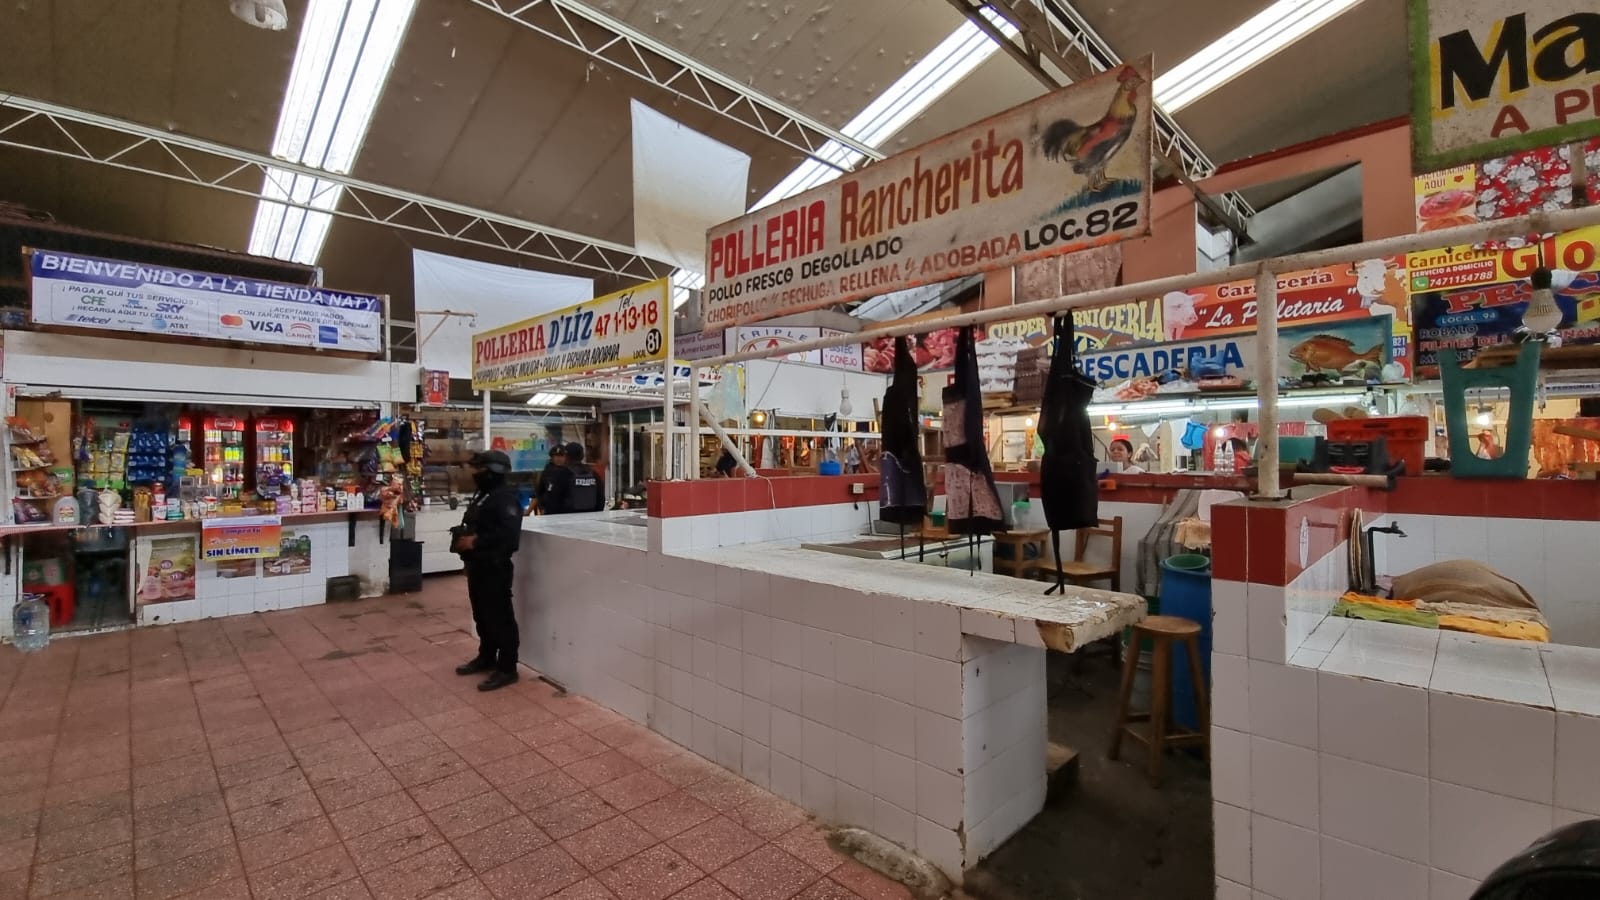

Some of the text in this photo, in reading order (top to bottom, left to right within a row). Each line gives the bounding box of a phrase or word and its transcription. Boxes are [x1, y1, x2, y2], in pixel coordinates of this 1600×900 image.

[1490, 104, 1530, 138] A
[710, 129, 1023, 284] POLLERIA Rancherita
[709, 236, 903, 304] POLLO FRESCO DEGOLLADO
[782, 279, 836, 307] PECHUGA
[839, 262, 901, 293] RELLENA
[920, 233, 1023, 276] ADOBADA
[1412, 267, 1444, 278] SERVICIO
[1452, 260, 1494, 272] DOMICILIO
[1429, 271, 1494, 287] 7471154788
[41, 254, 377, 311] BIENVENIDO A LA TIENDA NATY
[156, 302, 184, 313] SKY
[250, 320, 284, 333] VISA
[1441, 315, 1477, 324] LOCAL
[476, 324, 546, 364] POLLERIA
[647, 331, 660, 353] 81
[830, 354, 857, 366] CONEJO
[206, 548, 224, 558] SIN
[225, 545, 260, 555] LÍMITE
